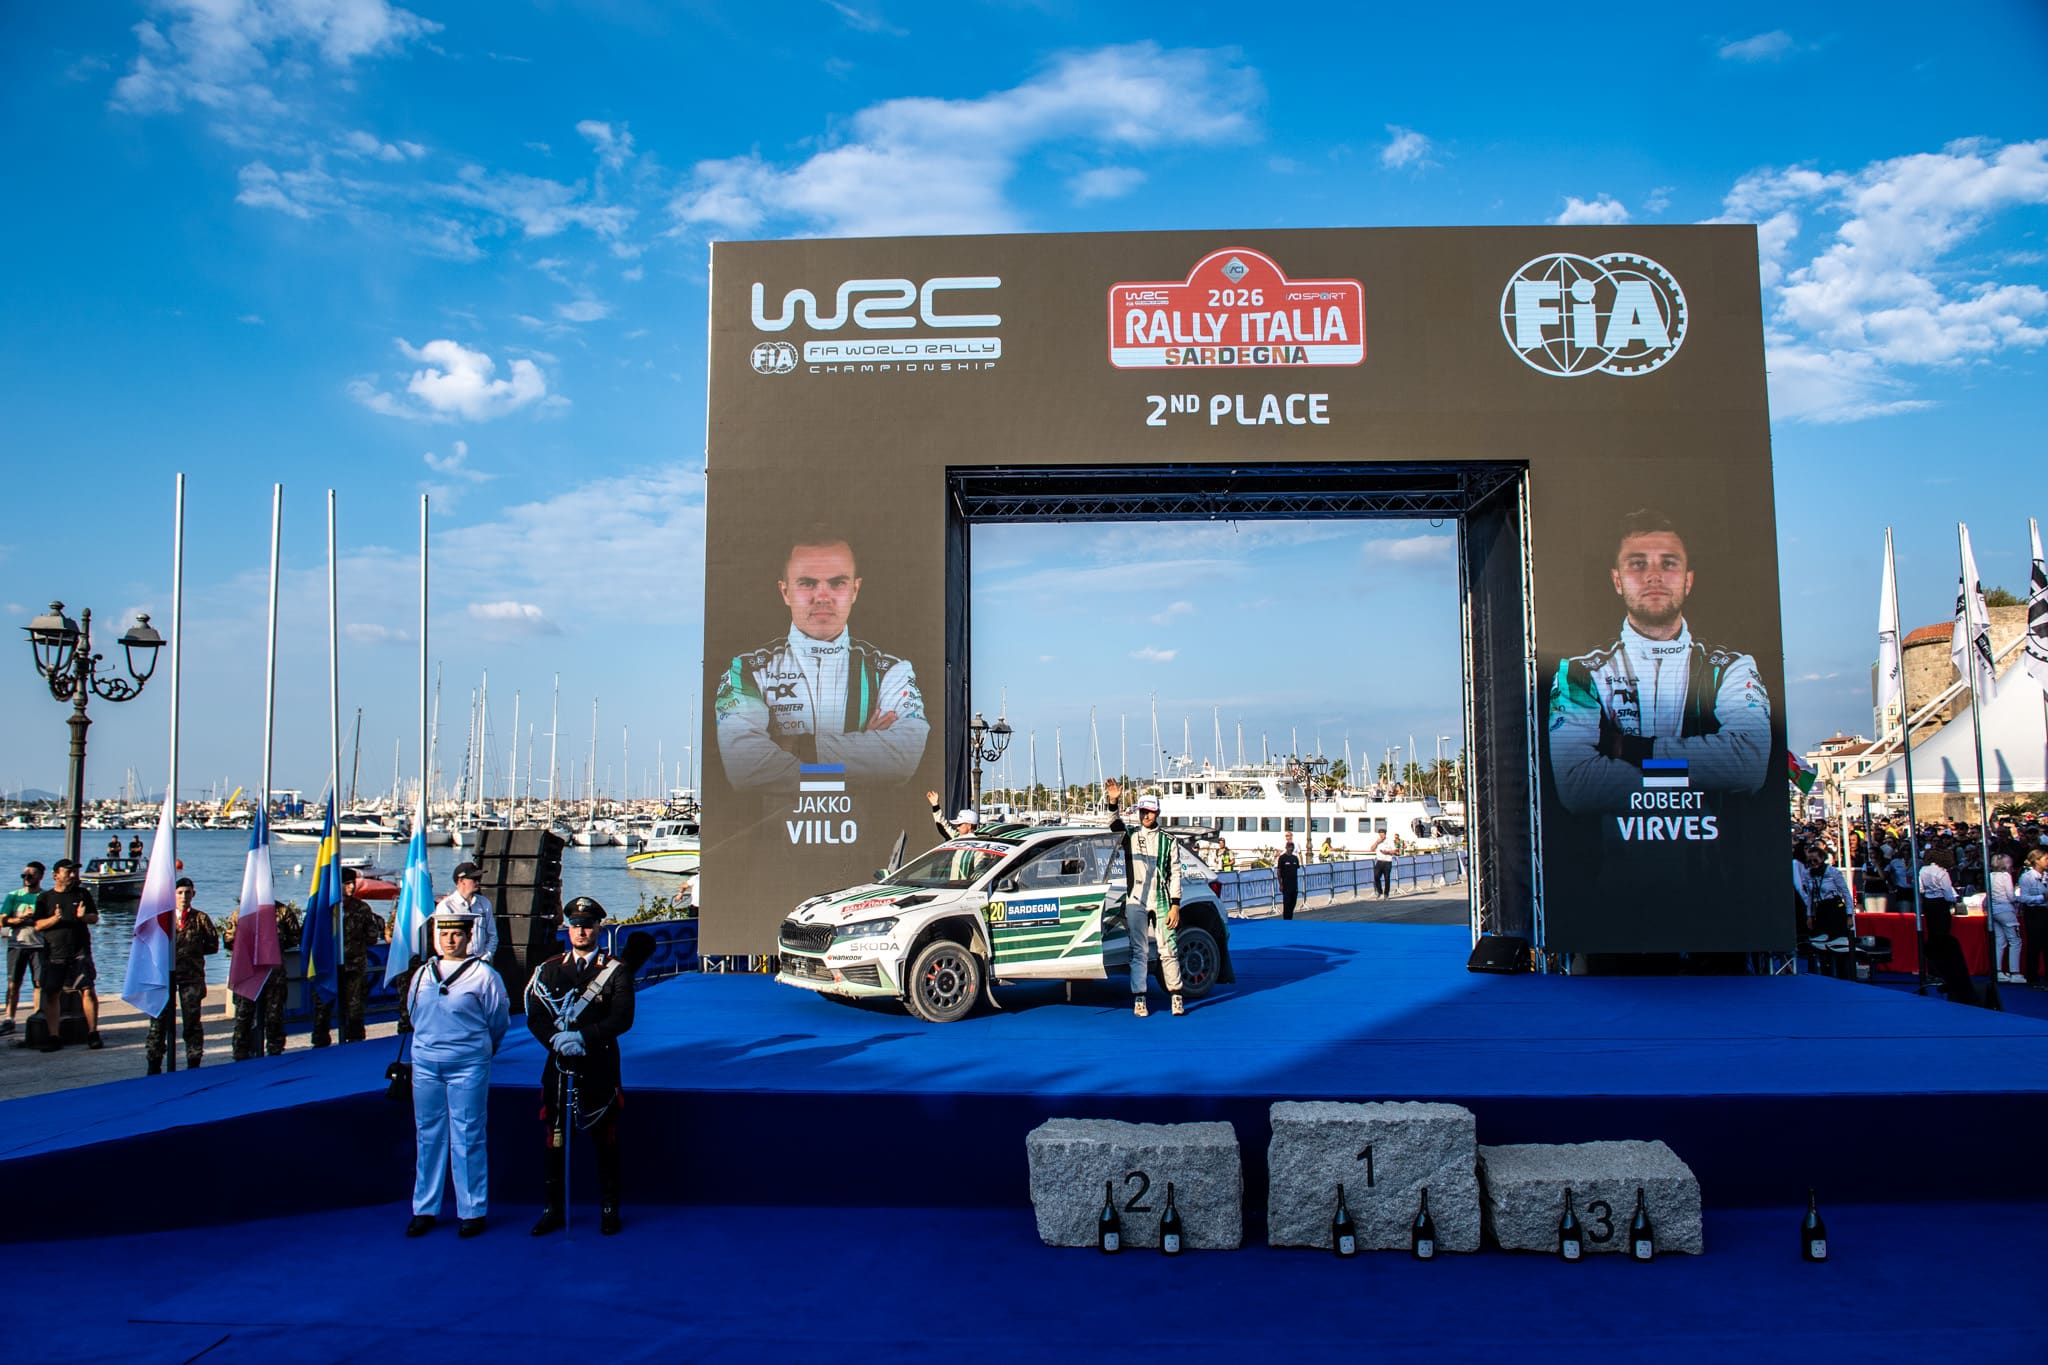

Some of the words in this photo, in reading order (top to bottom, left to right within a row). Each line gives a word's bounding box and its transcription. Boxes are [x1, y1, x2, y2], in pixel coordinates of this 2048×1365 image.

[751, 276, 1001, 331] WRC
[1125, 290, 1169, 301] WRC
[1208, 289, 1264, 306] 2026
[1125, 308, 1228, 344] RALLY
[1241, 305, 1348, 342] ITALIA
[809, 346, 839, 356] FIA
[845, 345, 918, 355] WORLD
[924, 343, 995, 353] RALLY
[1165, 346, 1309, 366] SARDEGNA
[809, 362, 996, 374] CHAMPIONSHIP
[1209, 393, 1330, 425] PLACE
[792, 796, 851, 814] JAKKO
[1630, 791, 1705, 810] ROBERT
[786, 820, 858, 845] VIILO
[1617, 815, 1720, 841] VIRVES
[989, 902, 1005, 921] 20
[1007, 903, 1058, 915] SARDEGNA
[1357, 1144, 1375, 1187] 1
[1124, 1171, 1151, 1212] 2
[1587, 1200, 1614, 1243] 3
